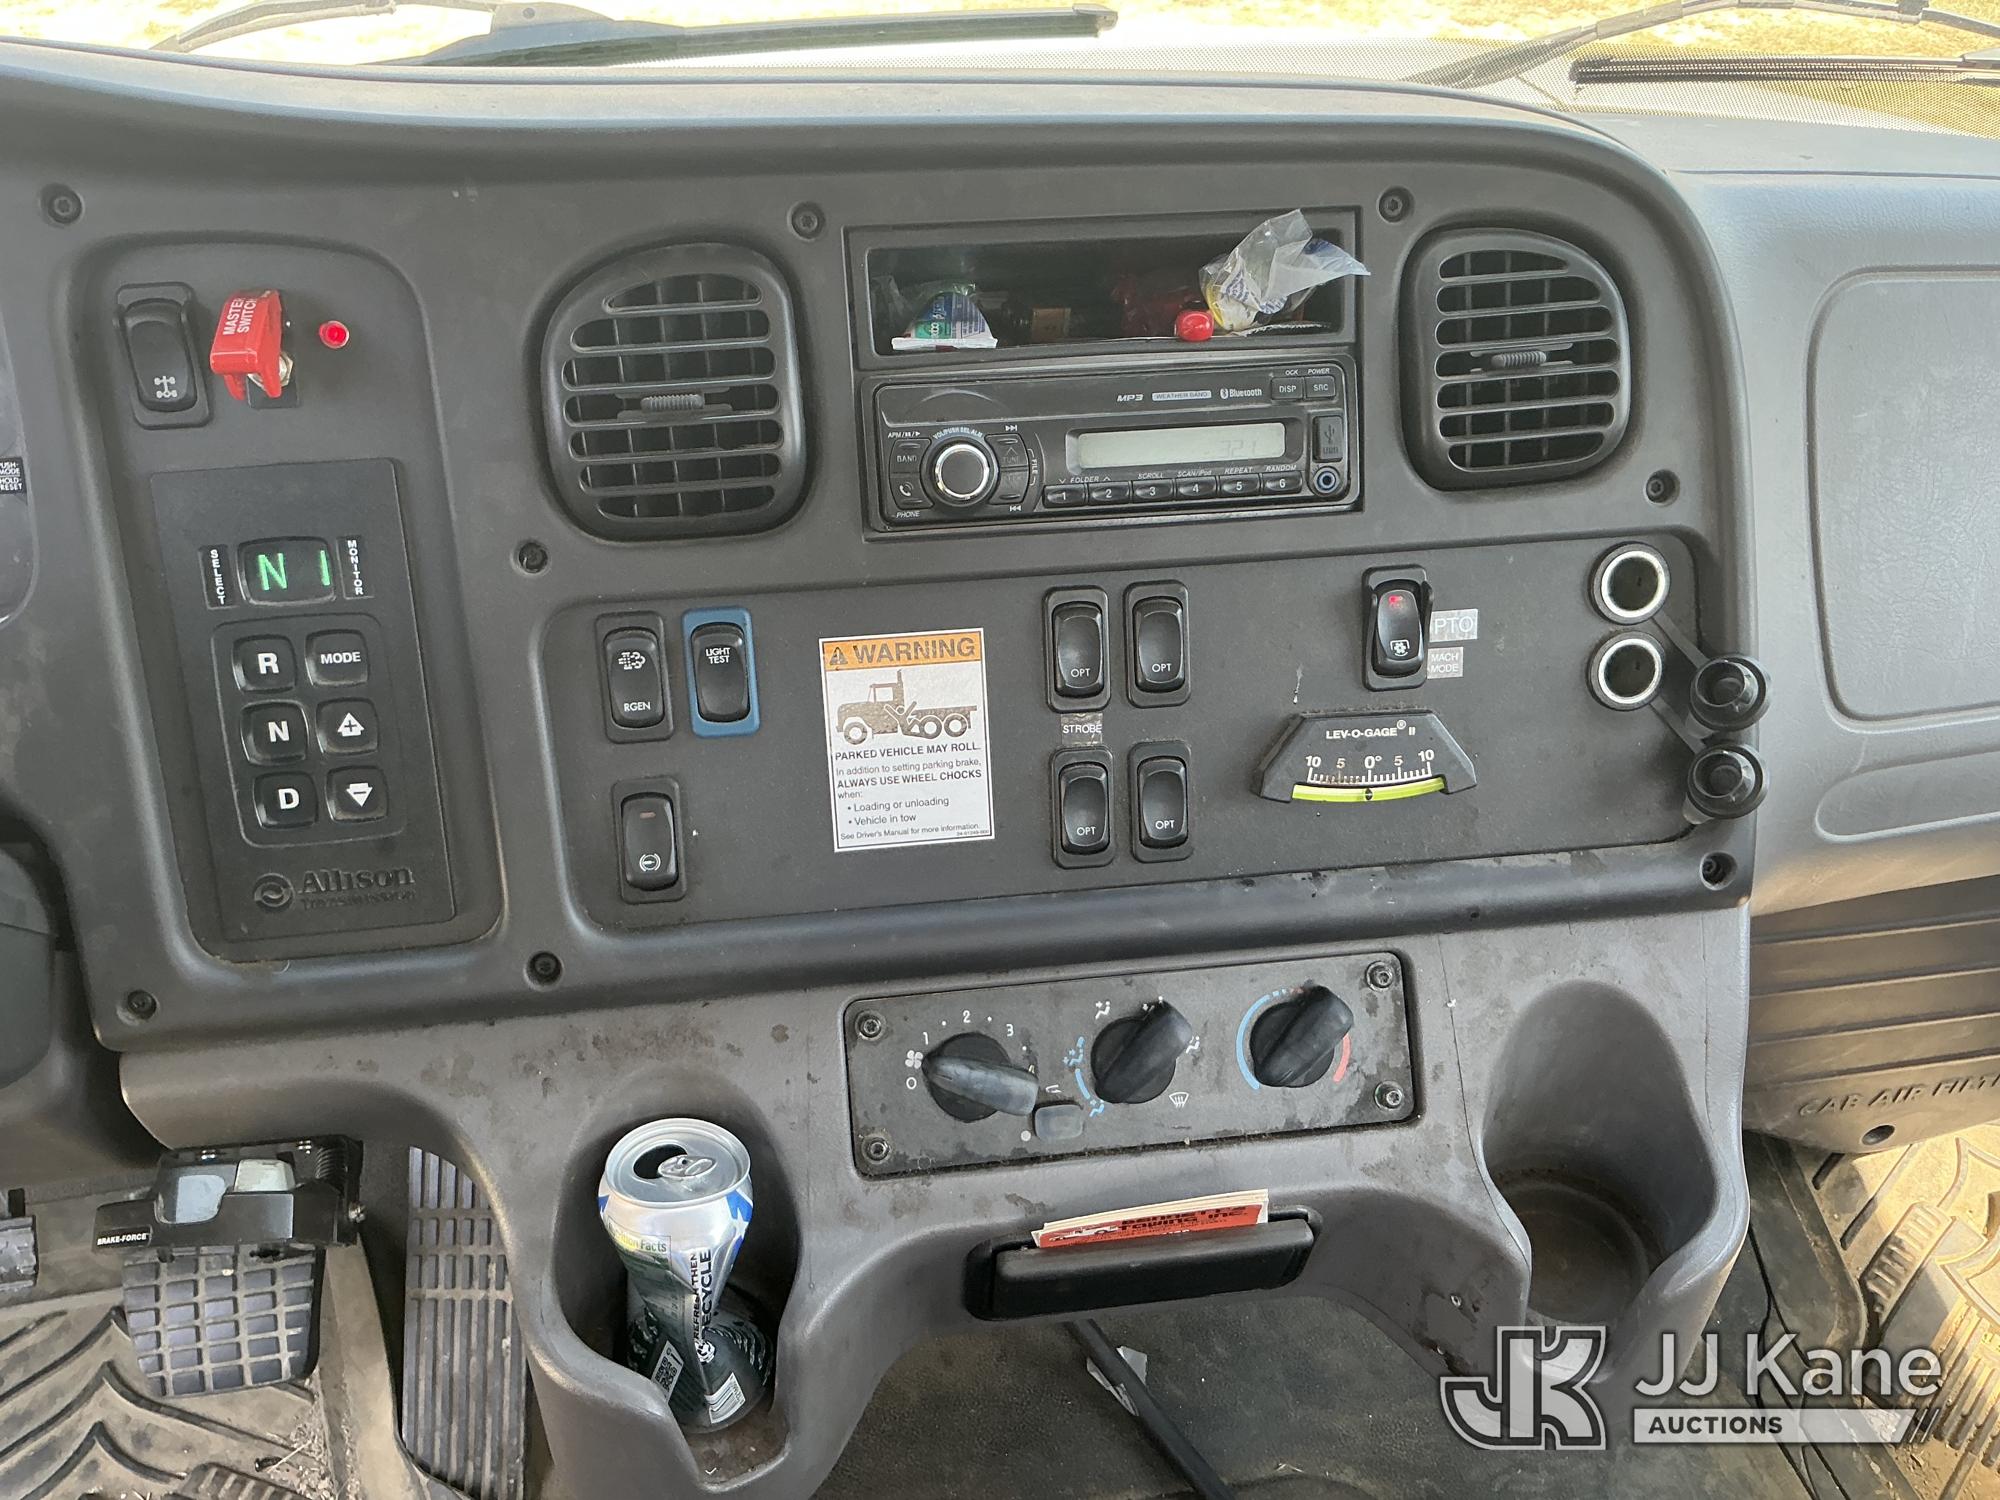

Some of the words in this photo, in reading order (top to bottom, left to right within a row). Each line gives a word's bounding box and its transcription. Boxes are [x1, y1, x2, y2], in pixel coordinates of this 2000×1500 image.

[1229, 387, 1262, 398] Bluetooth
[1279, 385, 1297, 393] DISP
[1313, 384, 1329, 392] SRC
[1116, 393, 1144, 402] MP3
[1156, 392, 1188, 400] WEATHER
[1189, 391, 1208, 399] BAND
[1265, 464, 1297, 472] RANDOM
[1070, 476, 1100, 484] FOLDER
[1279, 479, 1286, 488] 6
[1149, 486, 1156, 496] 3
[1192, 484, 1199, 493] 4
[1236, 481, 1243, 491] 5
[1061, 491, 1066, 500] 1
[1105, 489, 1112, 498] 2
[257, 552, 288, 591] N
[347, 539, 364, 595] MONITOR
[210, 549, 226, 605] SELECT
[1434, 616, 1474, 635] PTO
[705, 647, 731, 657] LIGHT
[852, 637, 976, 664] WARNING
[320, 651, 361, 665] MODE
[708, 656, 730, 664] TEST
[1431, 652, 1459, 661] MACH
[257, 652, 280, 675] R
[1151, 663, 1172, 673] OPT
[1430, 664, 1459, 673] MODE
[1070, 667, 1091, 678] OPT
[623, 701, 651, 712] RGEN
[268, 720, 290, 743] N
[1062, 724, 1103, 734] STROBE
[835, 749, 878, 761] PARKED
[879, 745, 924, 757] VEHICLE
[926, 743, 948, 754] MAY
[1305, 755, 1322, 767] 10
[1336, 757, 1346, 769] 5
[1394, 755, 1404, 766] 5
[1418, 749, 1435, 762] 10
[836, 767, 844, 776] In
[846, 765, 880, 775] addition
[881, 764, 890, 773] to
[892, 763, 920, 772] setting
[922, 759, 954, 770] parking
[955, 758, 982, 767] brake,
[837, 777, 878, 788] ALWAYS
[880, 775, 900, 785] USE
[901, 773, 938, 784] WHEEL
[939, 769, 982, 781] CHOCKS
[278, 788, 300, 810] D
[837, 791, 863, 799] when:
[853, 802, 891, 812] Loading
[892, 801, 902, 809] or
[905, 796, 950, 808] unloading
[854, 815, 888, 825] Vehicle
[889, 814, 898, 822] in
[900, 814, 917, 823] tow
[1155, 820, 1175, 830] OPT
[856, 830, 882, 839] Driver's
[883, 827, 910, 836] Manual
[1076, 826, 1096, 836] OPT
[297, 866, 416, 894] Allison
[962, 1009, 971, 1023] 2
[1006, 1023, 1014, 1037] 3
[922, 1031, 929, 1045] 1
[1867, 1083, 1927, 1107] AIR
[97, 1233, 147, 1246] BRAKE-FORCE
[640, 1239, 667, 1252] Facts
[690, 1254, 699, 1286] THEN
